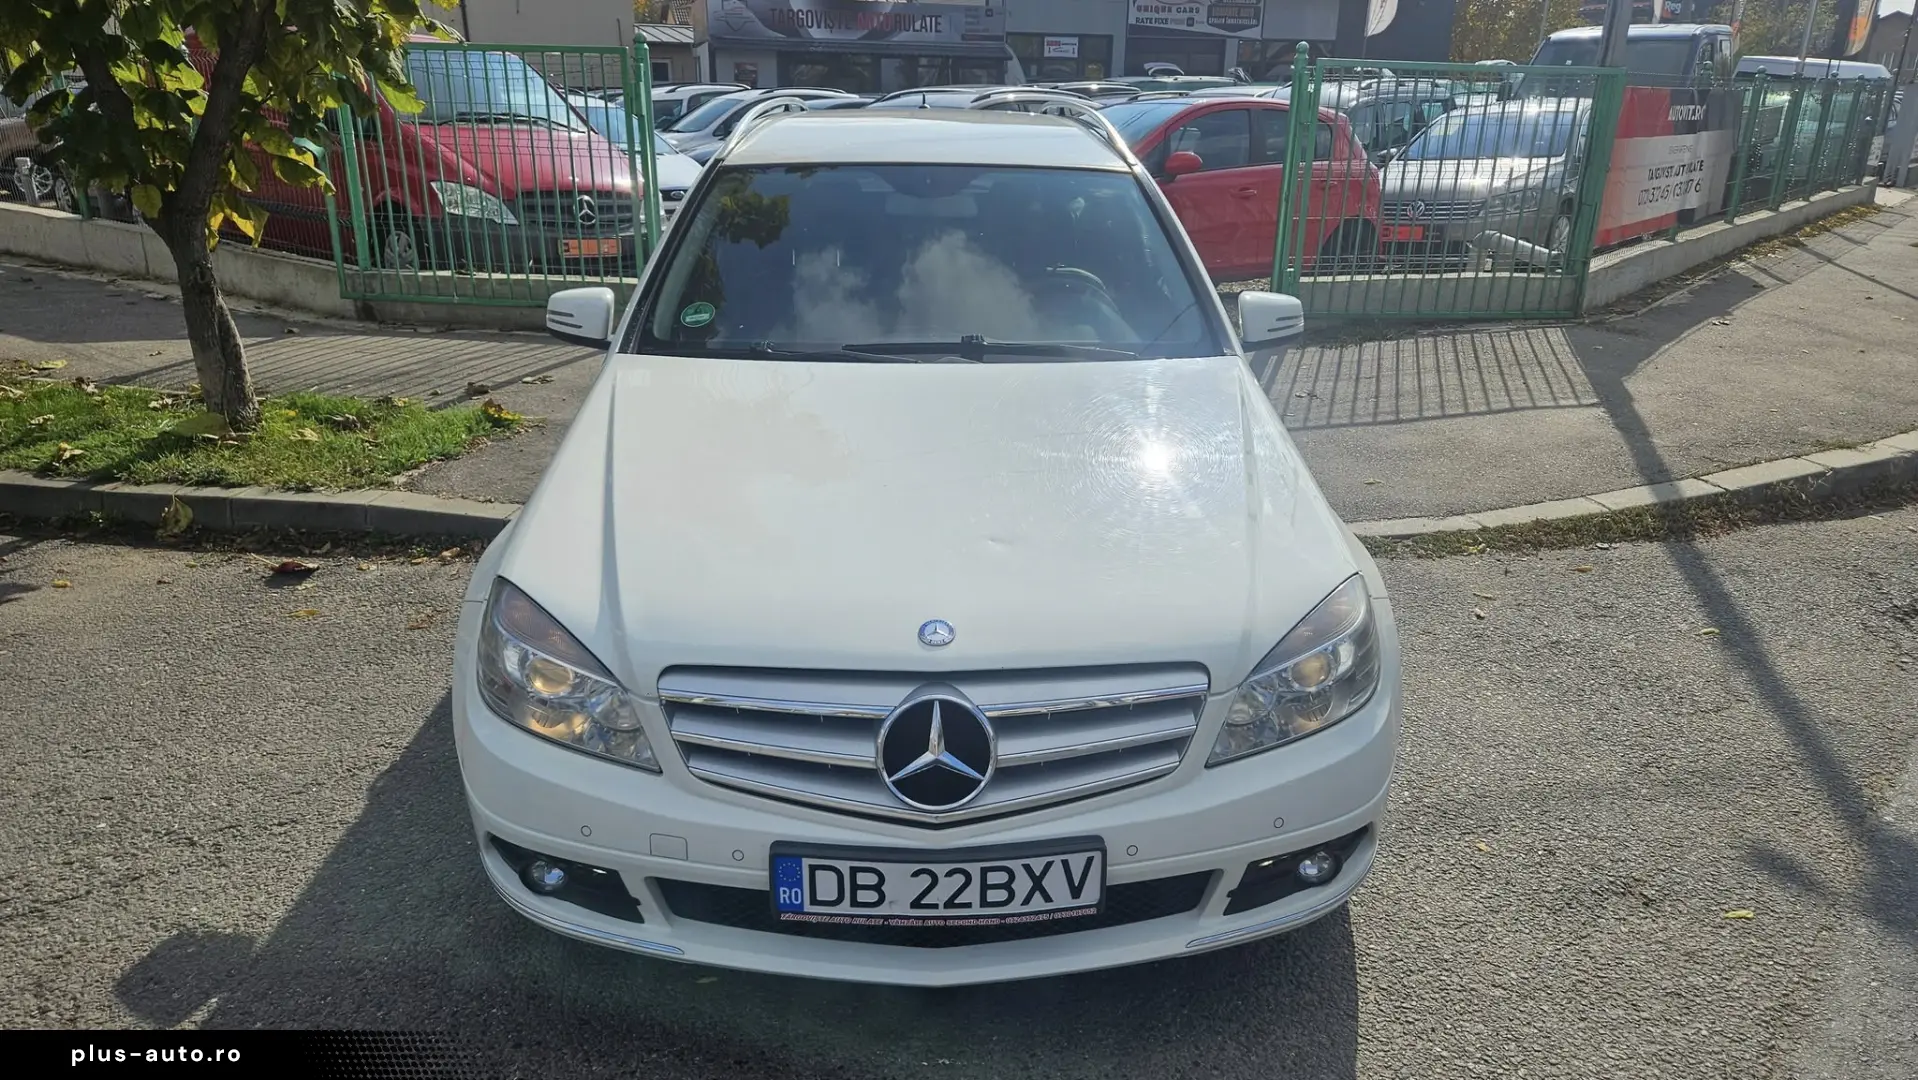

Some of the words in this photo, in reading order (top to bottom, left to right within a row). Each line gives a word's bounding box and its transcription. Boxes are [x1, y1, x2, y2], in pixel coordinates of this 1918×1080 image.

[1176, 6, 1200, 14] CARS
[1135, 17, 1153, 25] RATE
[1154, 17, 1169, 25] FIXE
[808, 863, 886, 910] DB
[909, 855, 1095, 910] 22BXV
[779, 887, 801, 905] RO
